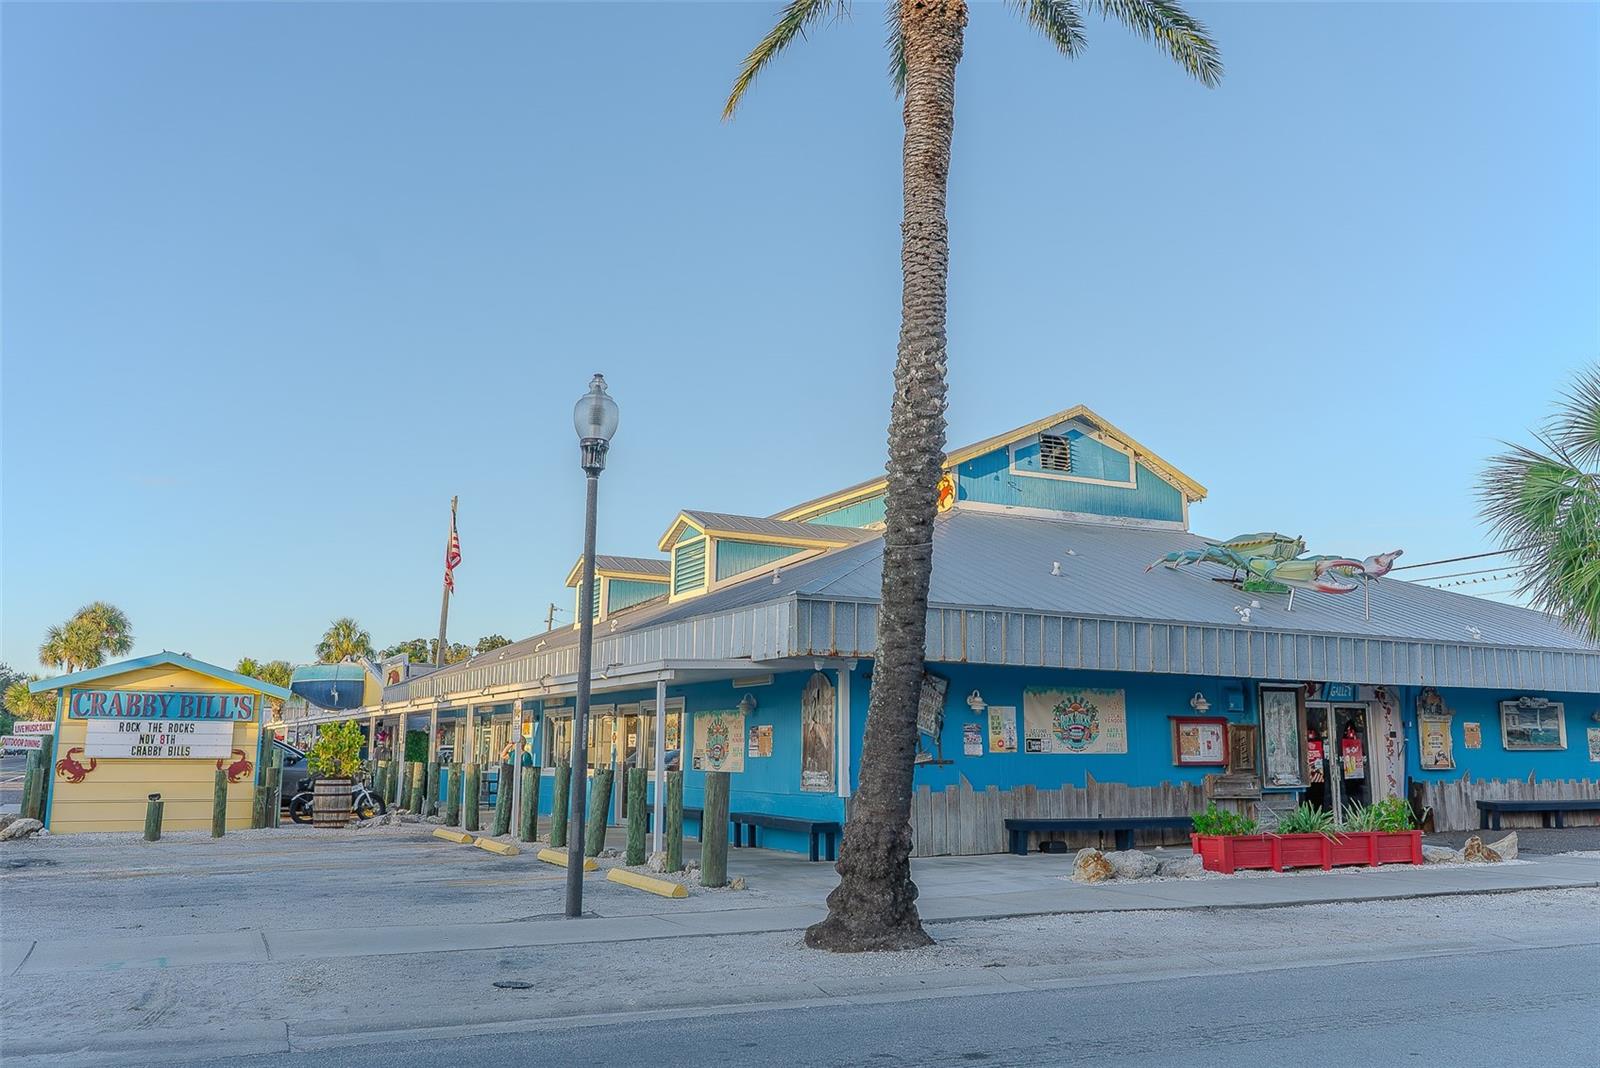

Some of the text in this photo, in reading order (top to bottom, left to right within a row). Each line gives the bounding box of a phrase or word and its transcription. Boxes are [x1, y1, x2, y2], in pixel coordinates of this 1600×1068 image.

[73, 691, 253, 720] CRABBY BILL'S
[14, 723, 52, 734] LIVE MUSIC DAILY
[119, 722, 195, 734] ROCK THE ROCKS
[1, 737, 41, 748] OUTDOOR DINING
[139, 733, 176, 745] NOV 8TH
[131, 745, 190, 757] CRABBY BILLS
